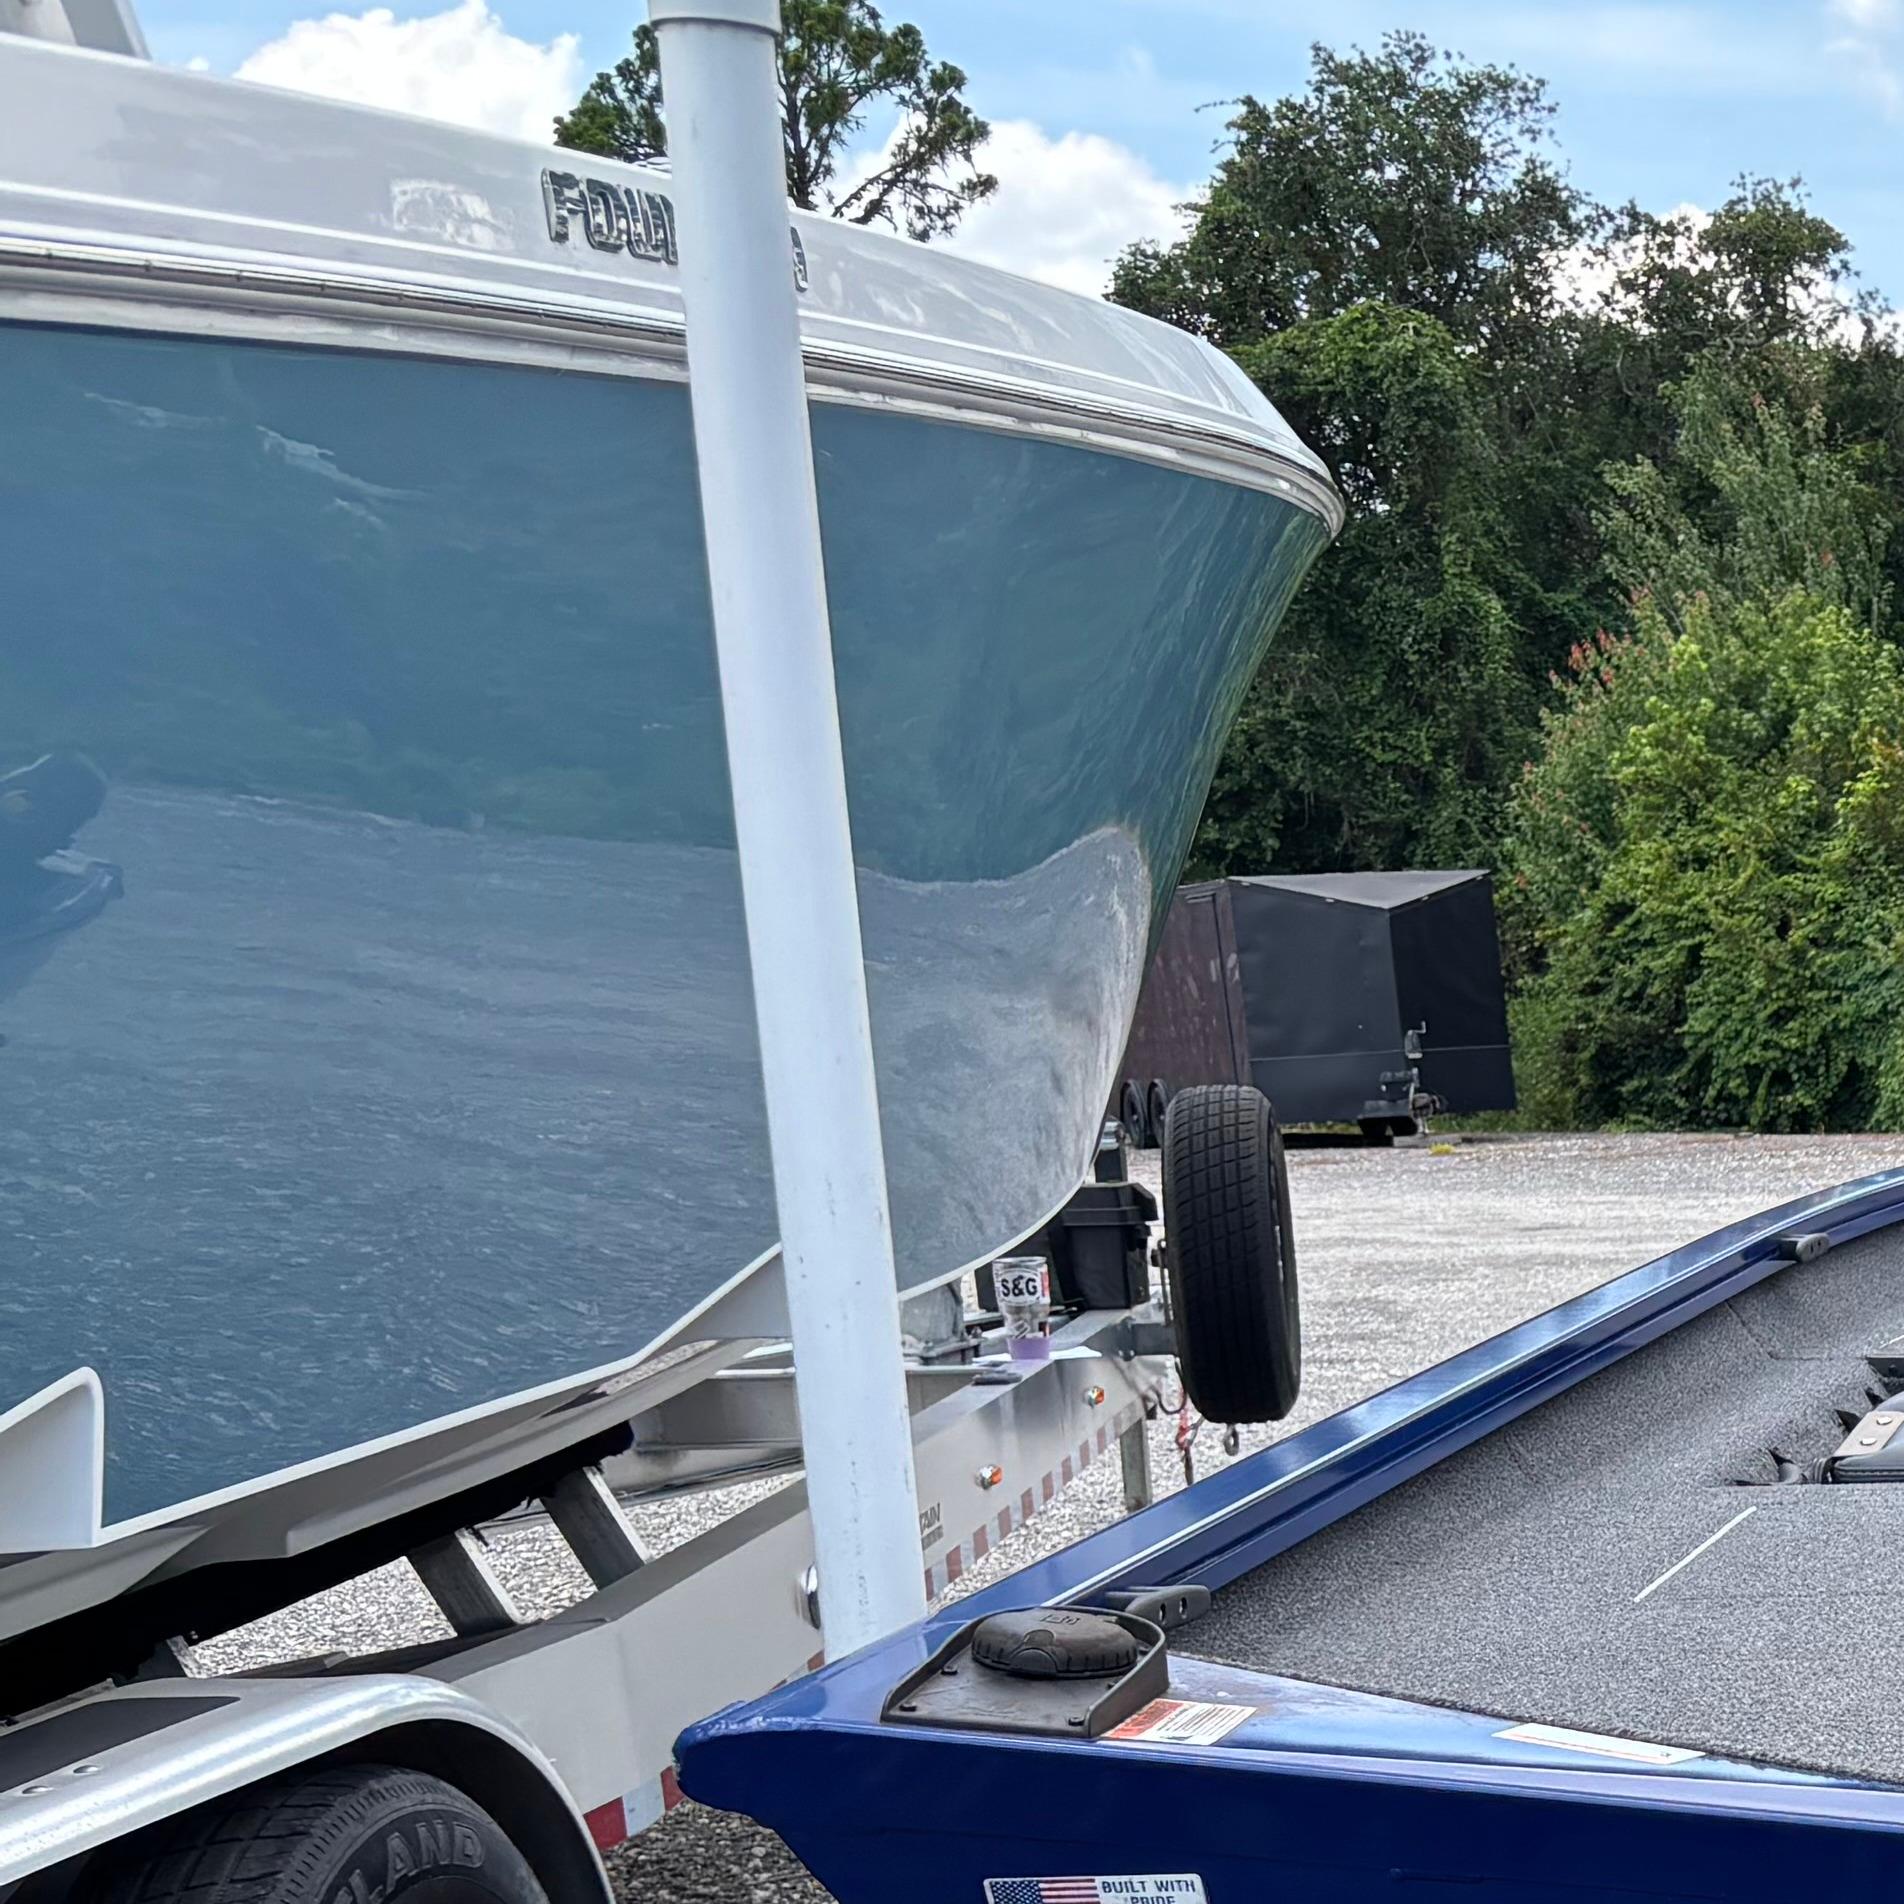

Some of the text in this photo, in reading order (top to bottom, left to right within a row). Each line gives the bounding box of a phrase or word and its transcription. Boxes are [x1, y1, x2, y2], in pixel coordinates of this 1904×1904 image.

[1001, 1273, 1039, 1298] S&G
[1101, 1879, 1197, 1894] BUILT WITH
